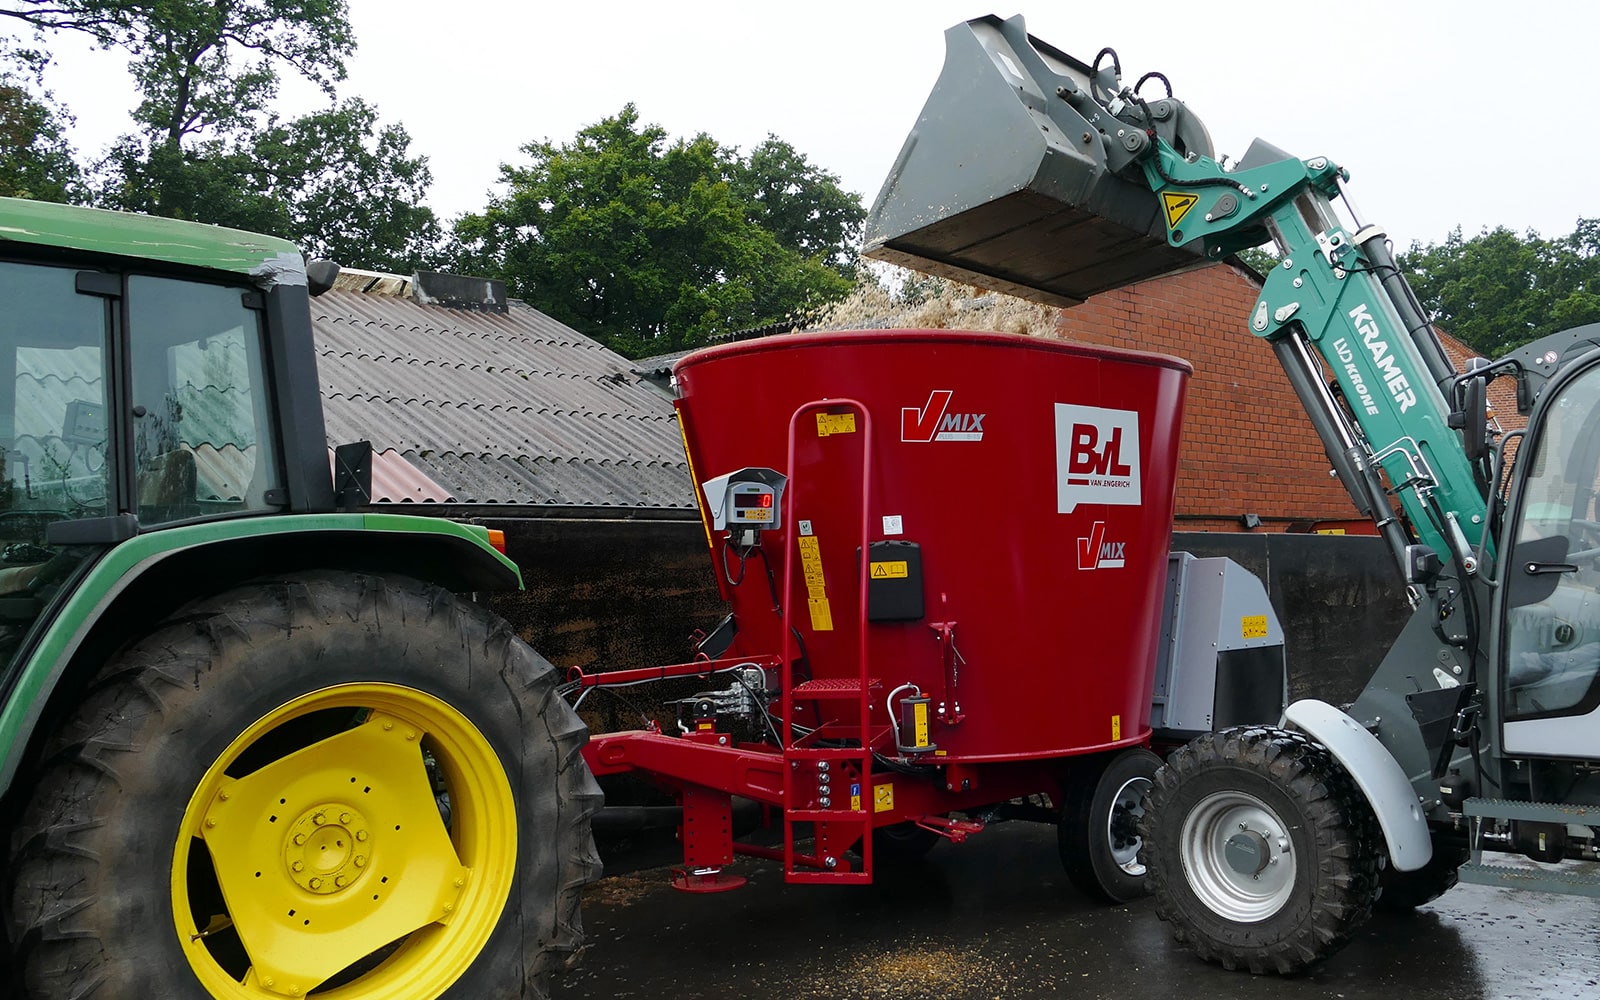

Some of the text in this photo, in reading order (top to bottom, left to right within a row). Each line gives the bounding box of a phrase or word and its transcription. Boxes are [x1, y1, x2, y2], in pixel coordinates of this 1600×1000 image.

[1349, 303, 1417, 413] KRAMER
[1344, 363, 1379, 415] KRONE
[1090, 479, 1102, 487] VAN
